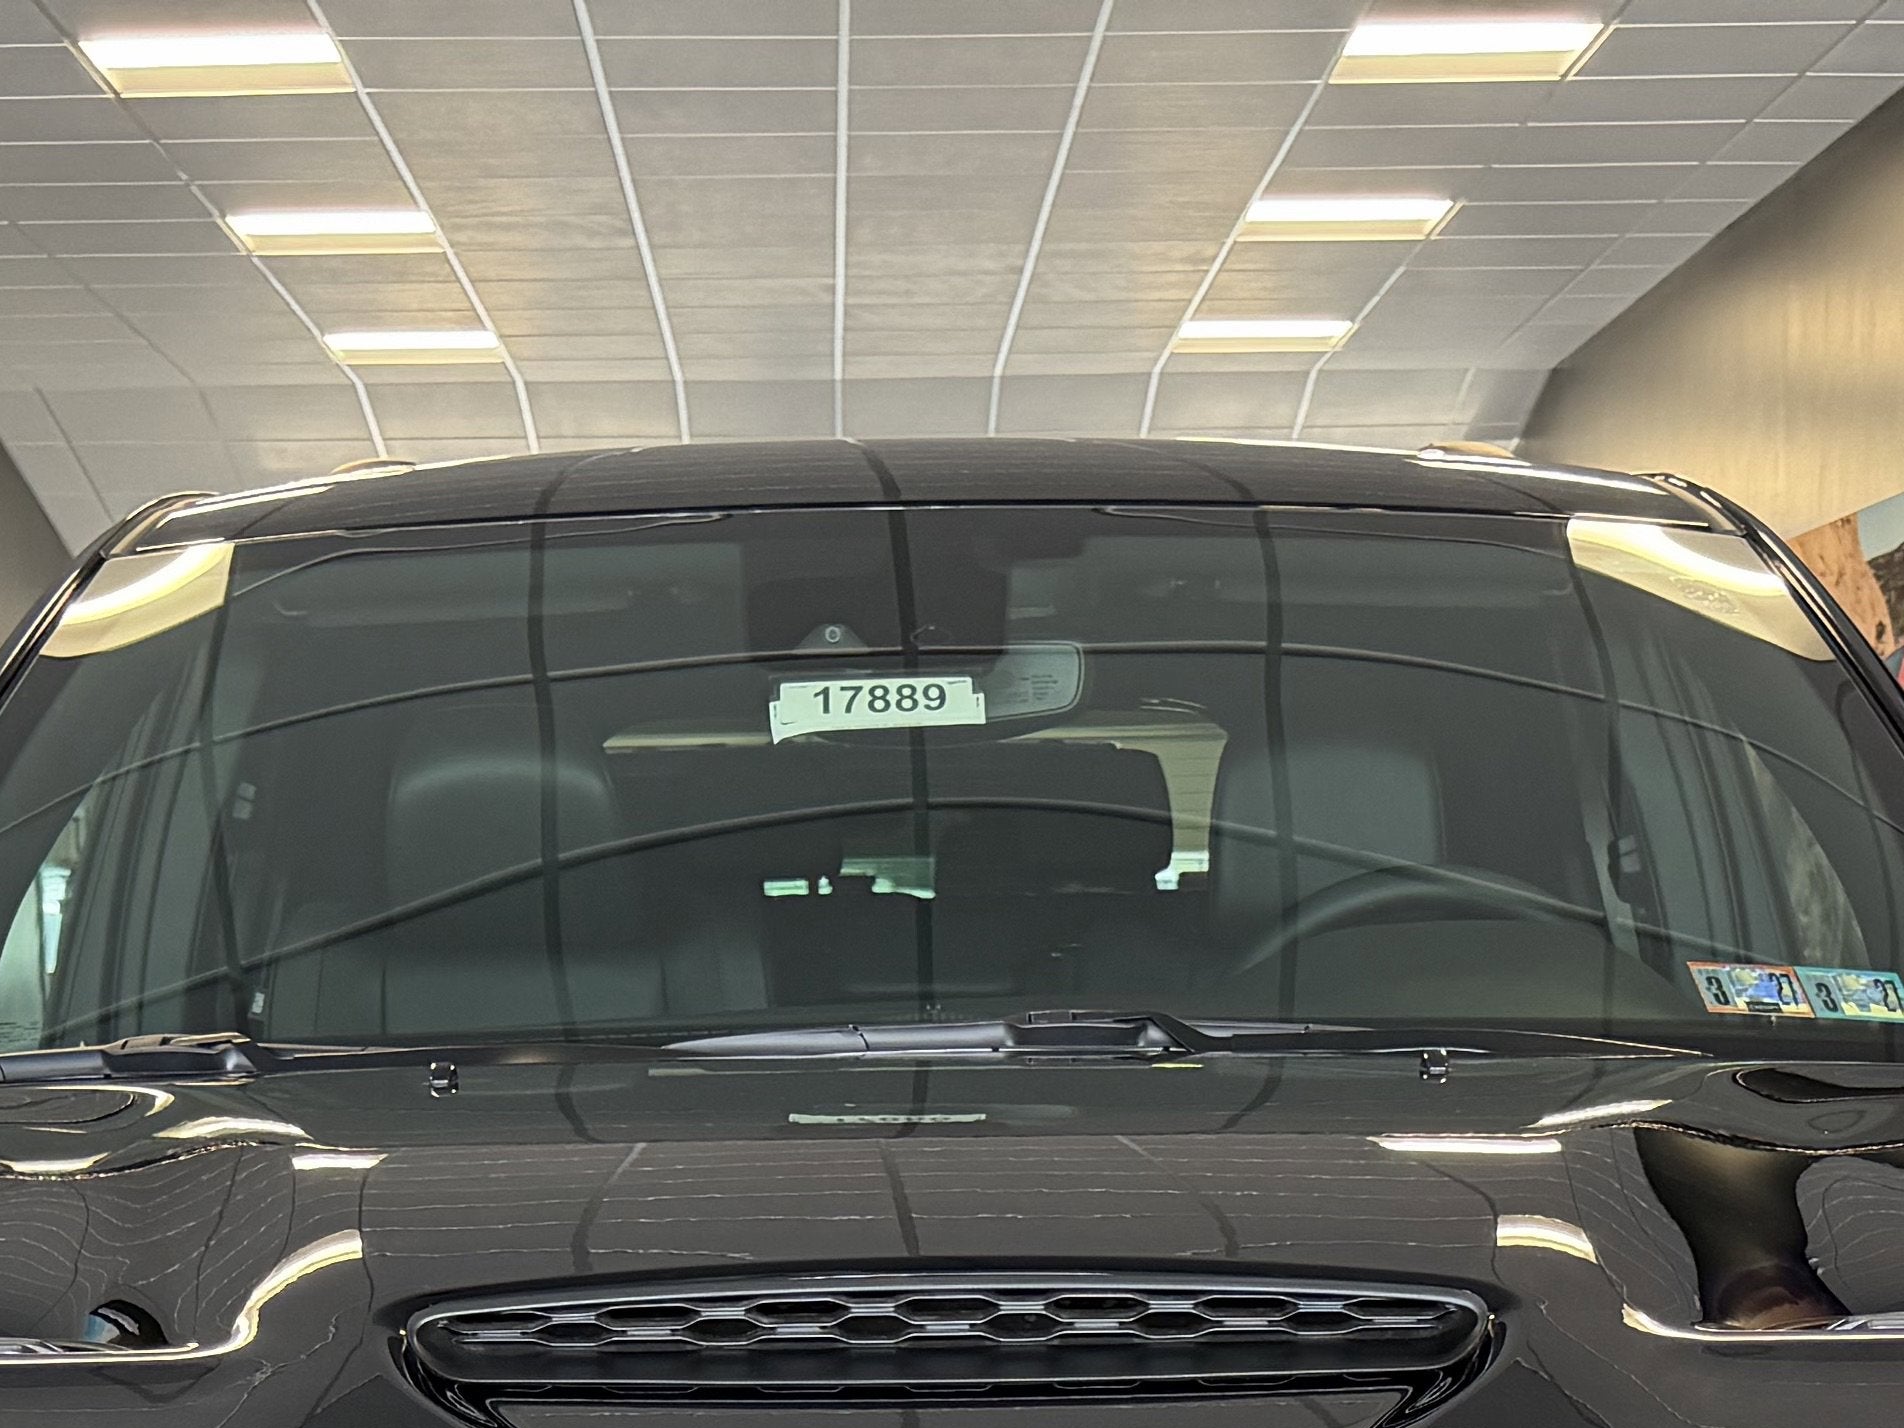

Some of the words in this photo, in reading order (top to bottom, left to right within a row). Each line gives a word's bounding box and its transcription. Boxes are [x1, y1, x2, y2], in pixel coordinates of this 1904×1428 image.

[812, 683, 947, 715] 17889
[1705, 975, 1731, 1006] 3
[1814, 981, 1840, 1014] 3
